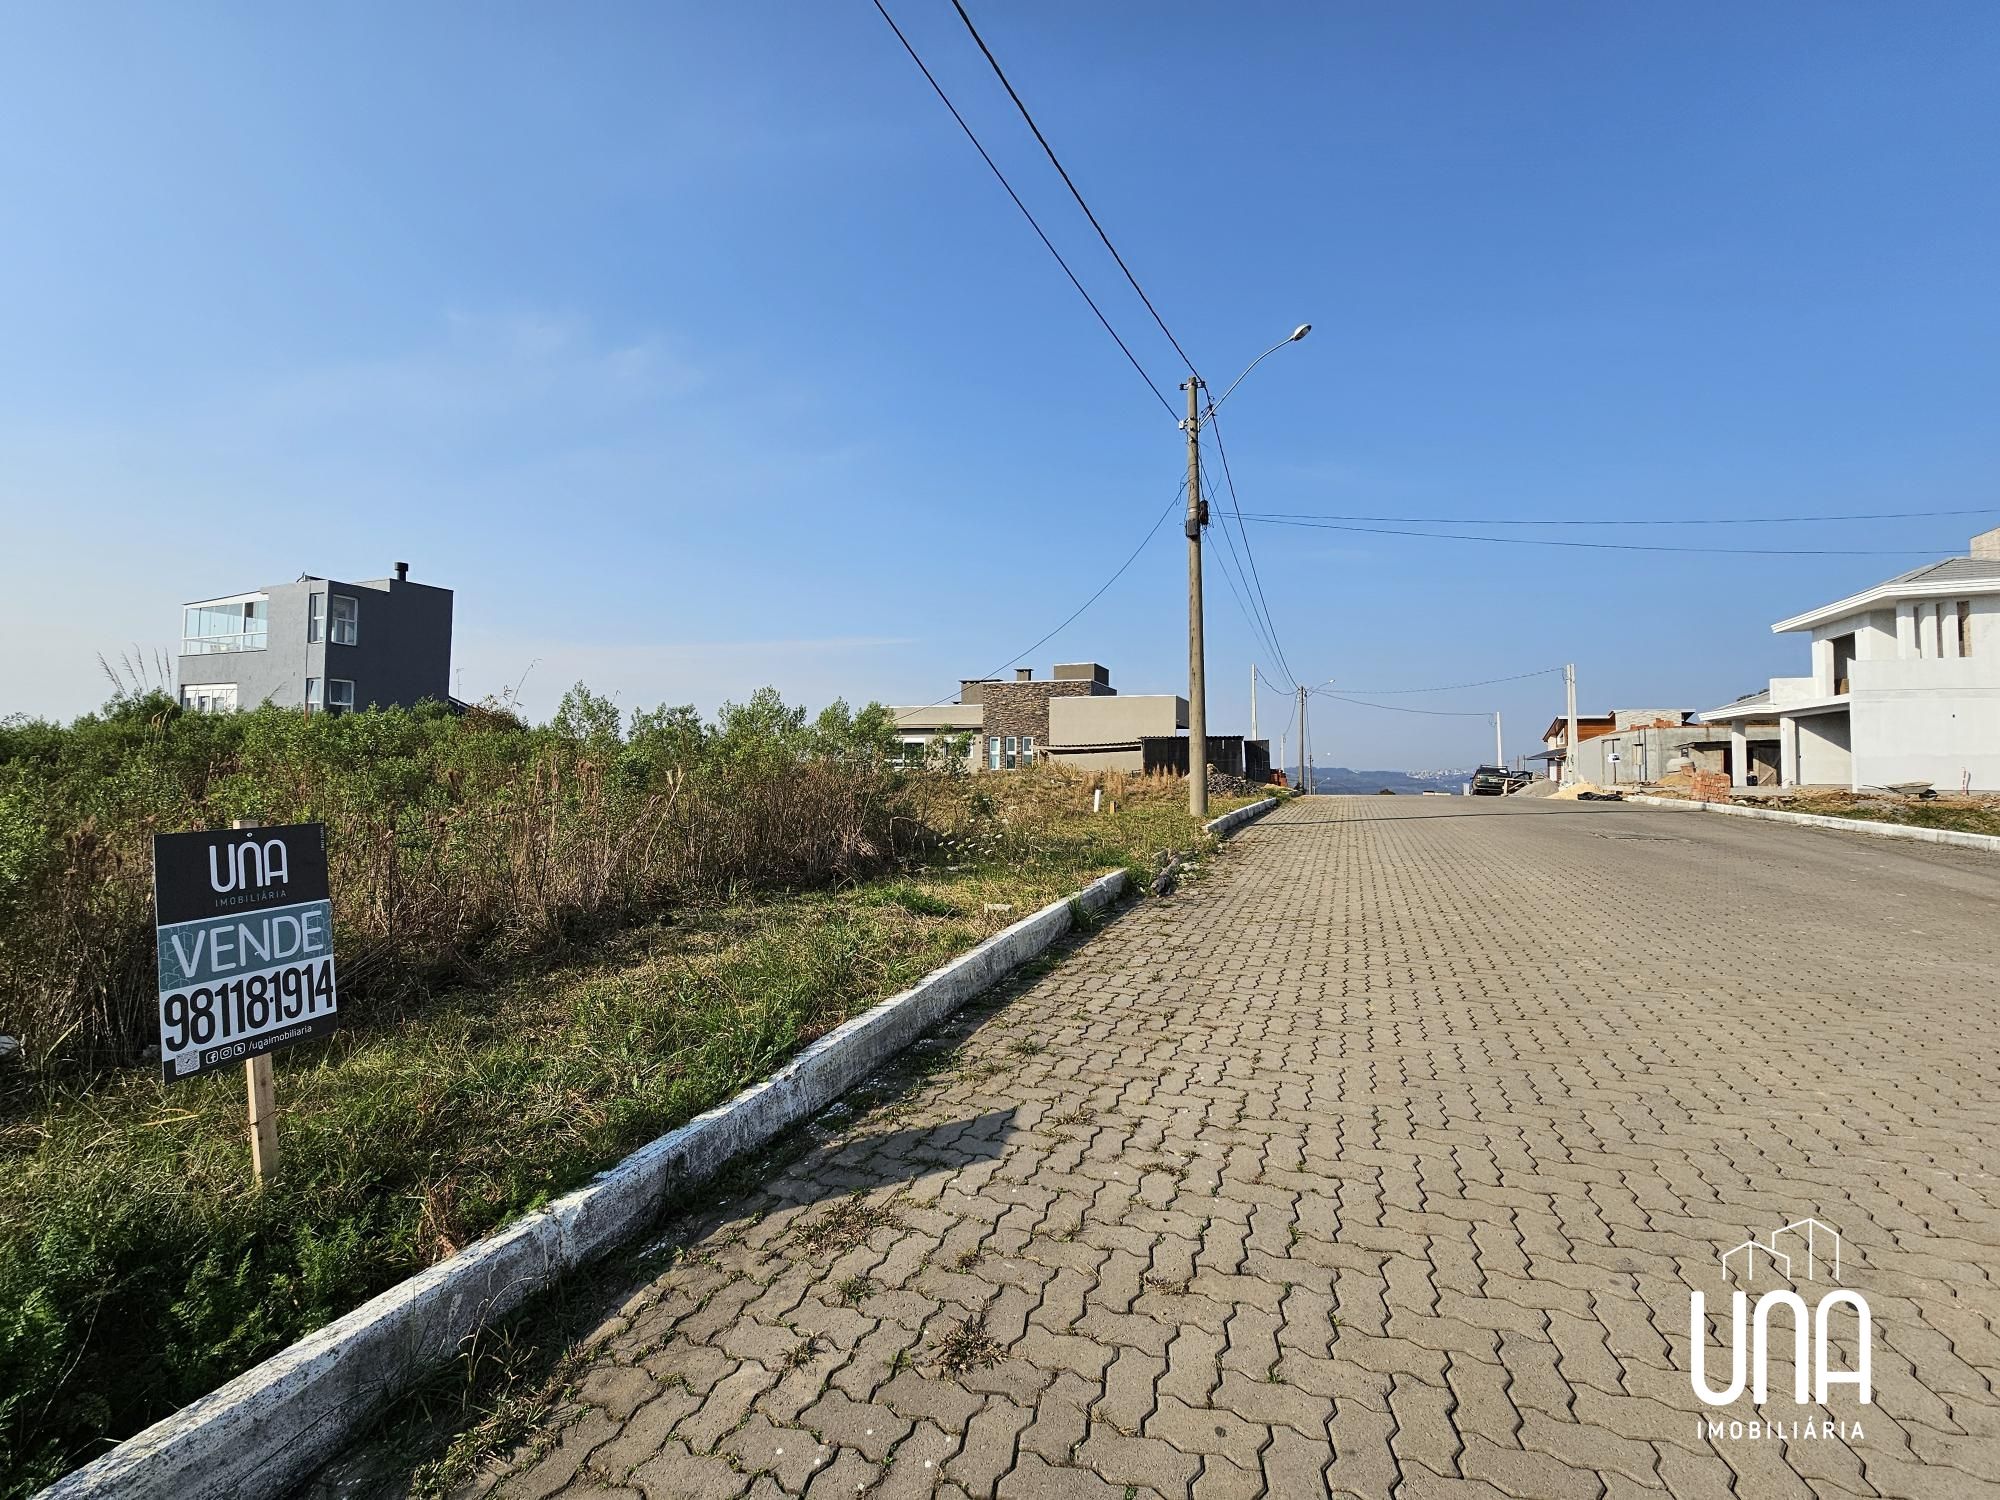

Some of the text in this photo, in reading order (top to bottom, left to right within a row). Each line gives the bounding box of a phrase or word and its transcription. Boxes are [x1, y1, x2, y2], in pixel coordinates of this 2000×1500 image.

[209, 839, 289, 893] UNA
[215, 889, 287, 907] IMOBILIÁRIA
[171, 910, 324, 978] VENDE
